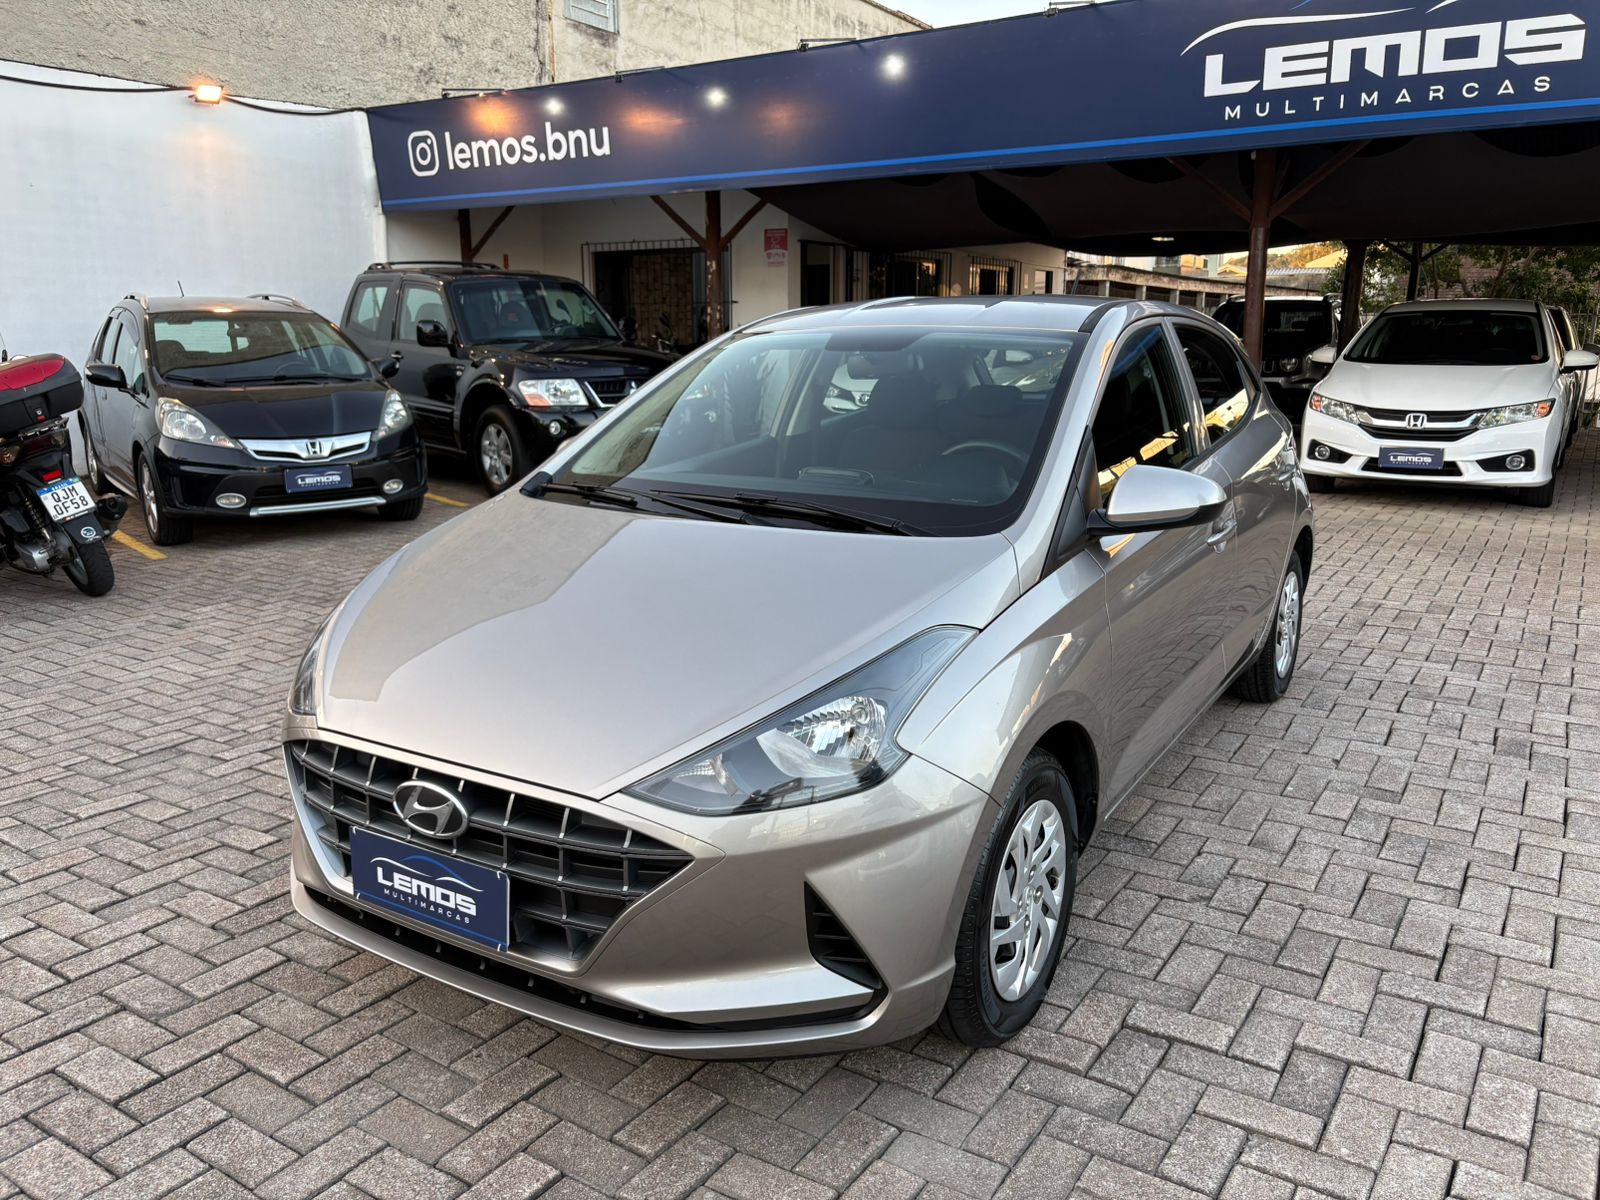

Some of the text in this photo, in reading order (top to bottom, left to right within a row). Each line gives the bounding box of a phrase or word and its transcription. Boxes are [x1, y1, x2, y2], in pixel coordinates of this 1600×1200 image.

[1204, 13, 1586, 97] LEMOS
[1224, 76, 1551, 120] MULTIMARCAS
[444, 121, 611, 170] lemos.bnu
[51, 486, 79, 503] QJM
[298, 475, 341, 485] LEMOS
[376, 866, 477, 916] LEMOS
[384, 888, 470, 924] MULTIMARCAS
